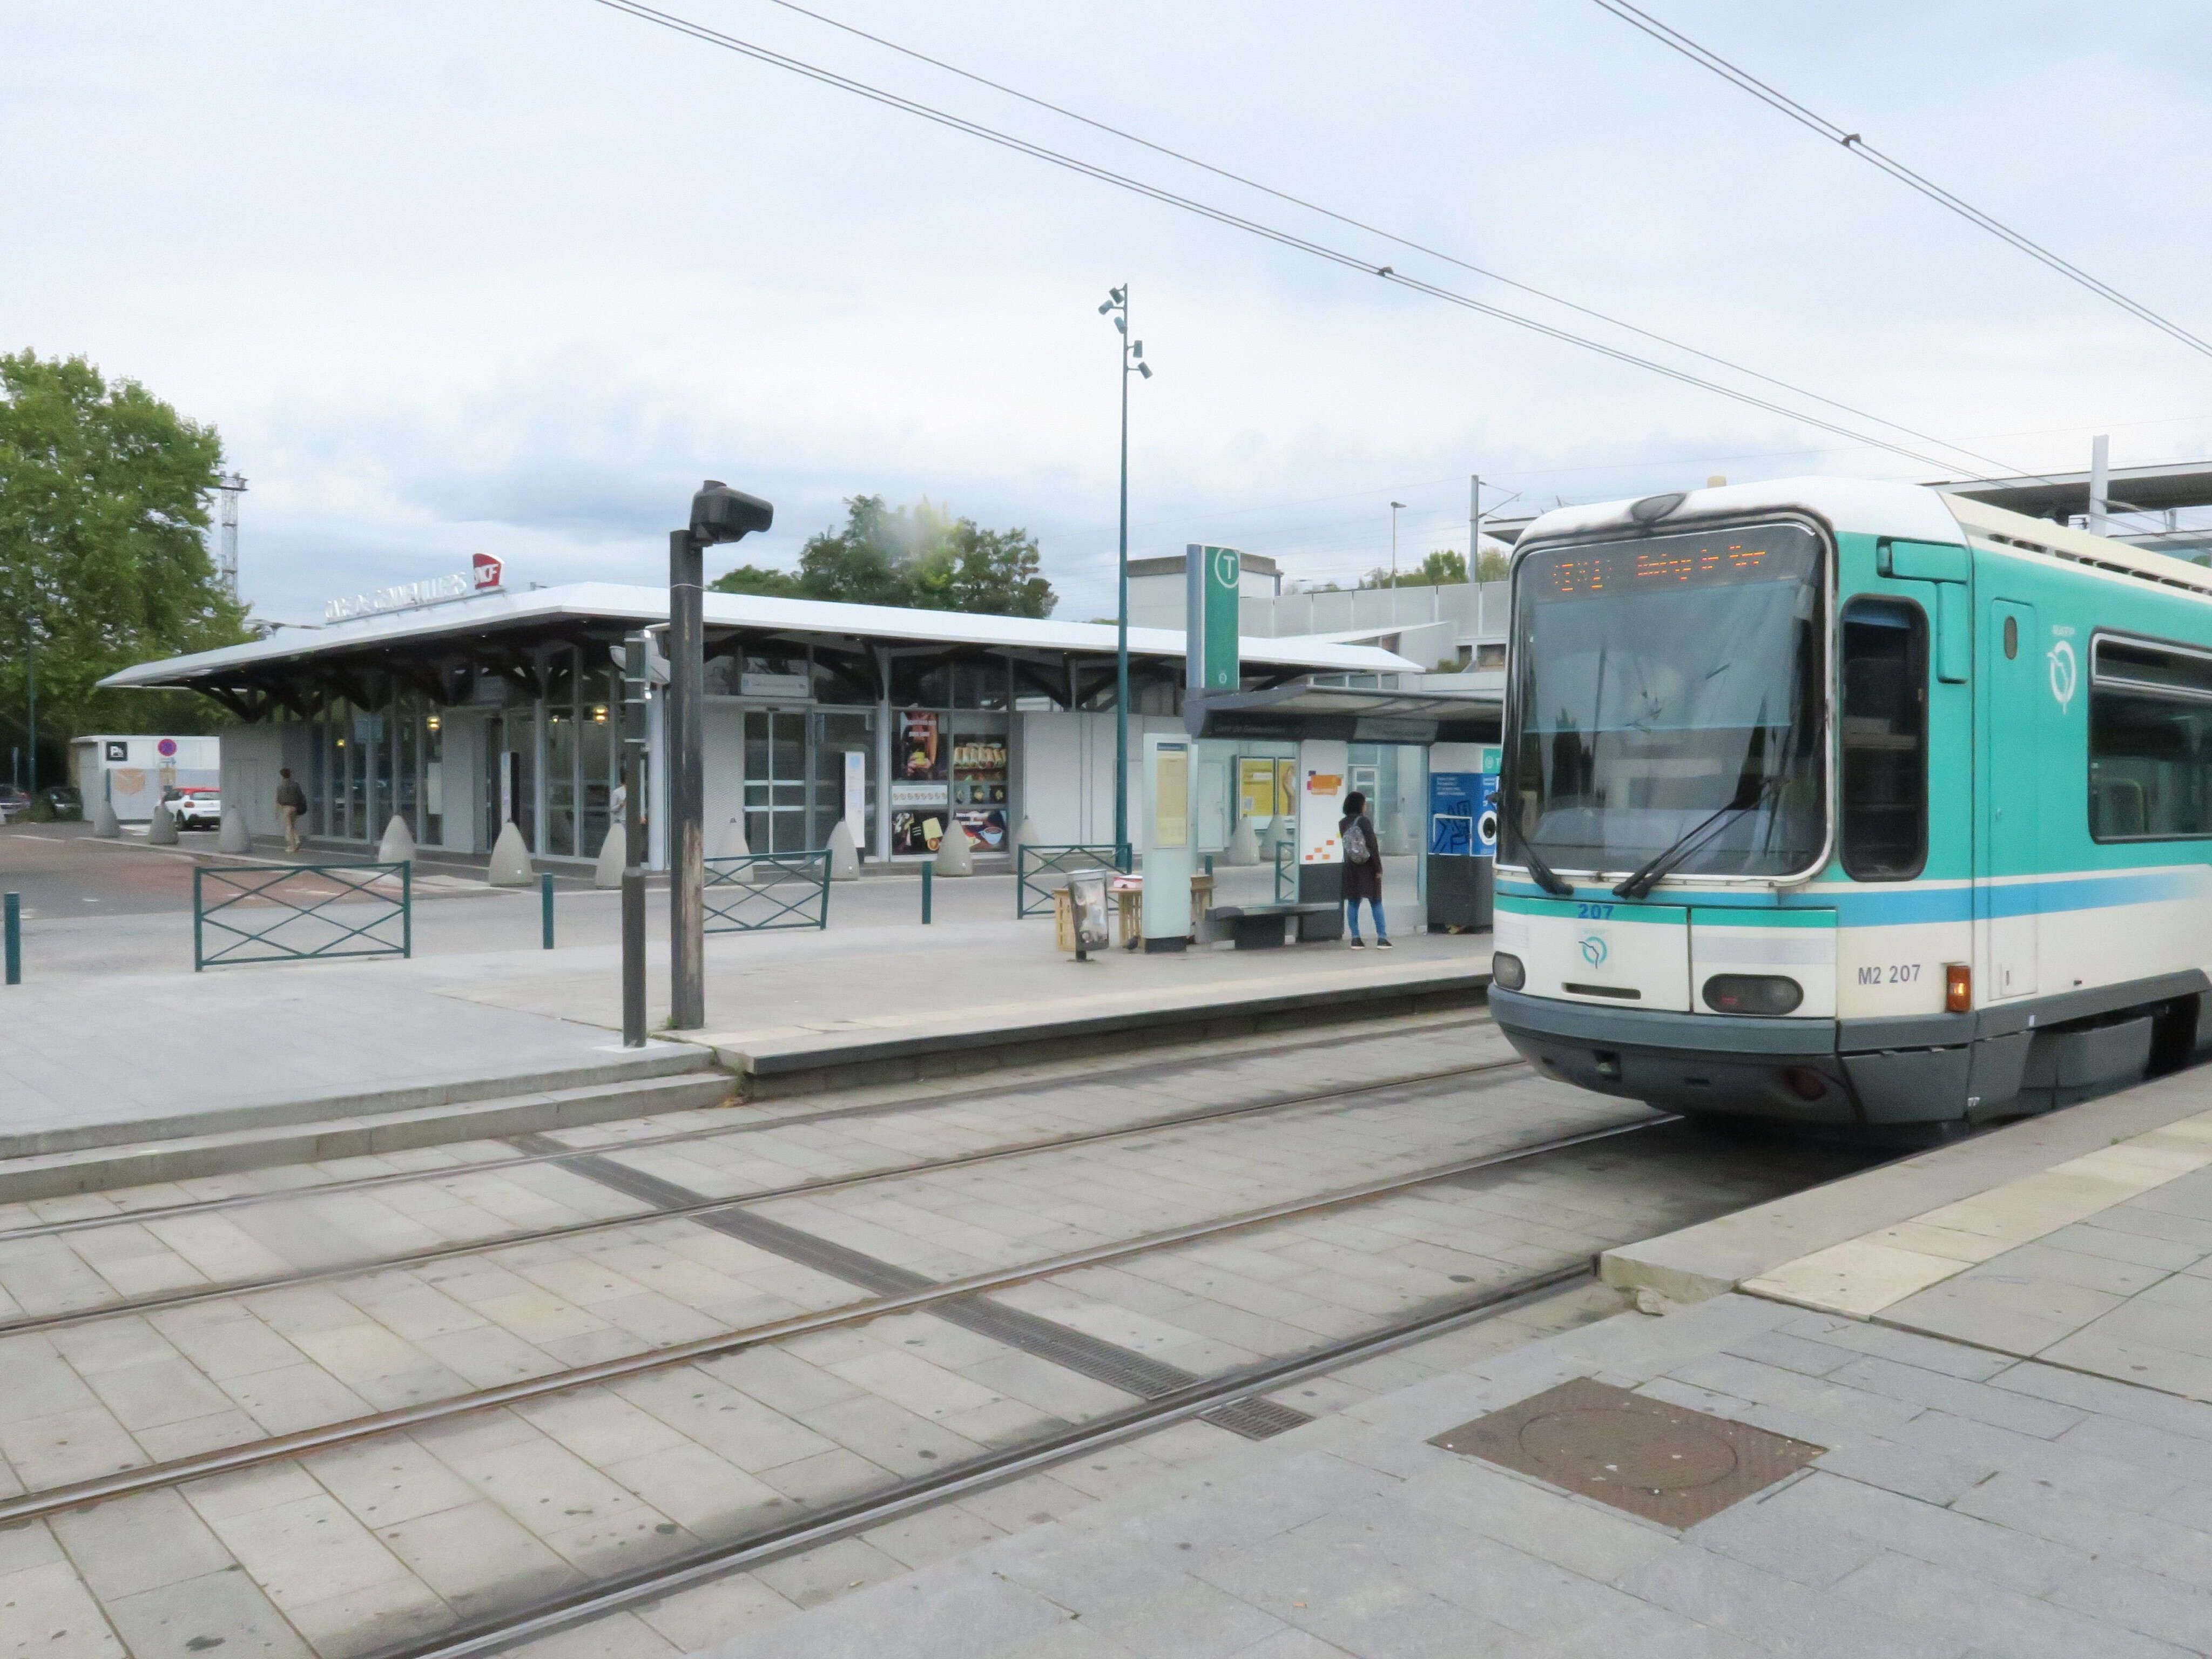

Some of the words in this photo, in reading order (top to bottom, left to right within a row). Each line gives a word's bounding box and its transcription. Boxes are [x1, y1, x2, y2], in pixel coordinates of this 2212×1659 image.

[1223, 555, 1236, 579] T
[1577, 903, 1615, 920] 207
[1858, 966, 1882, 985] M2
[1889, 964, 1921, 983] 207
